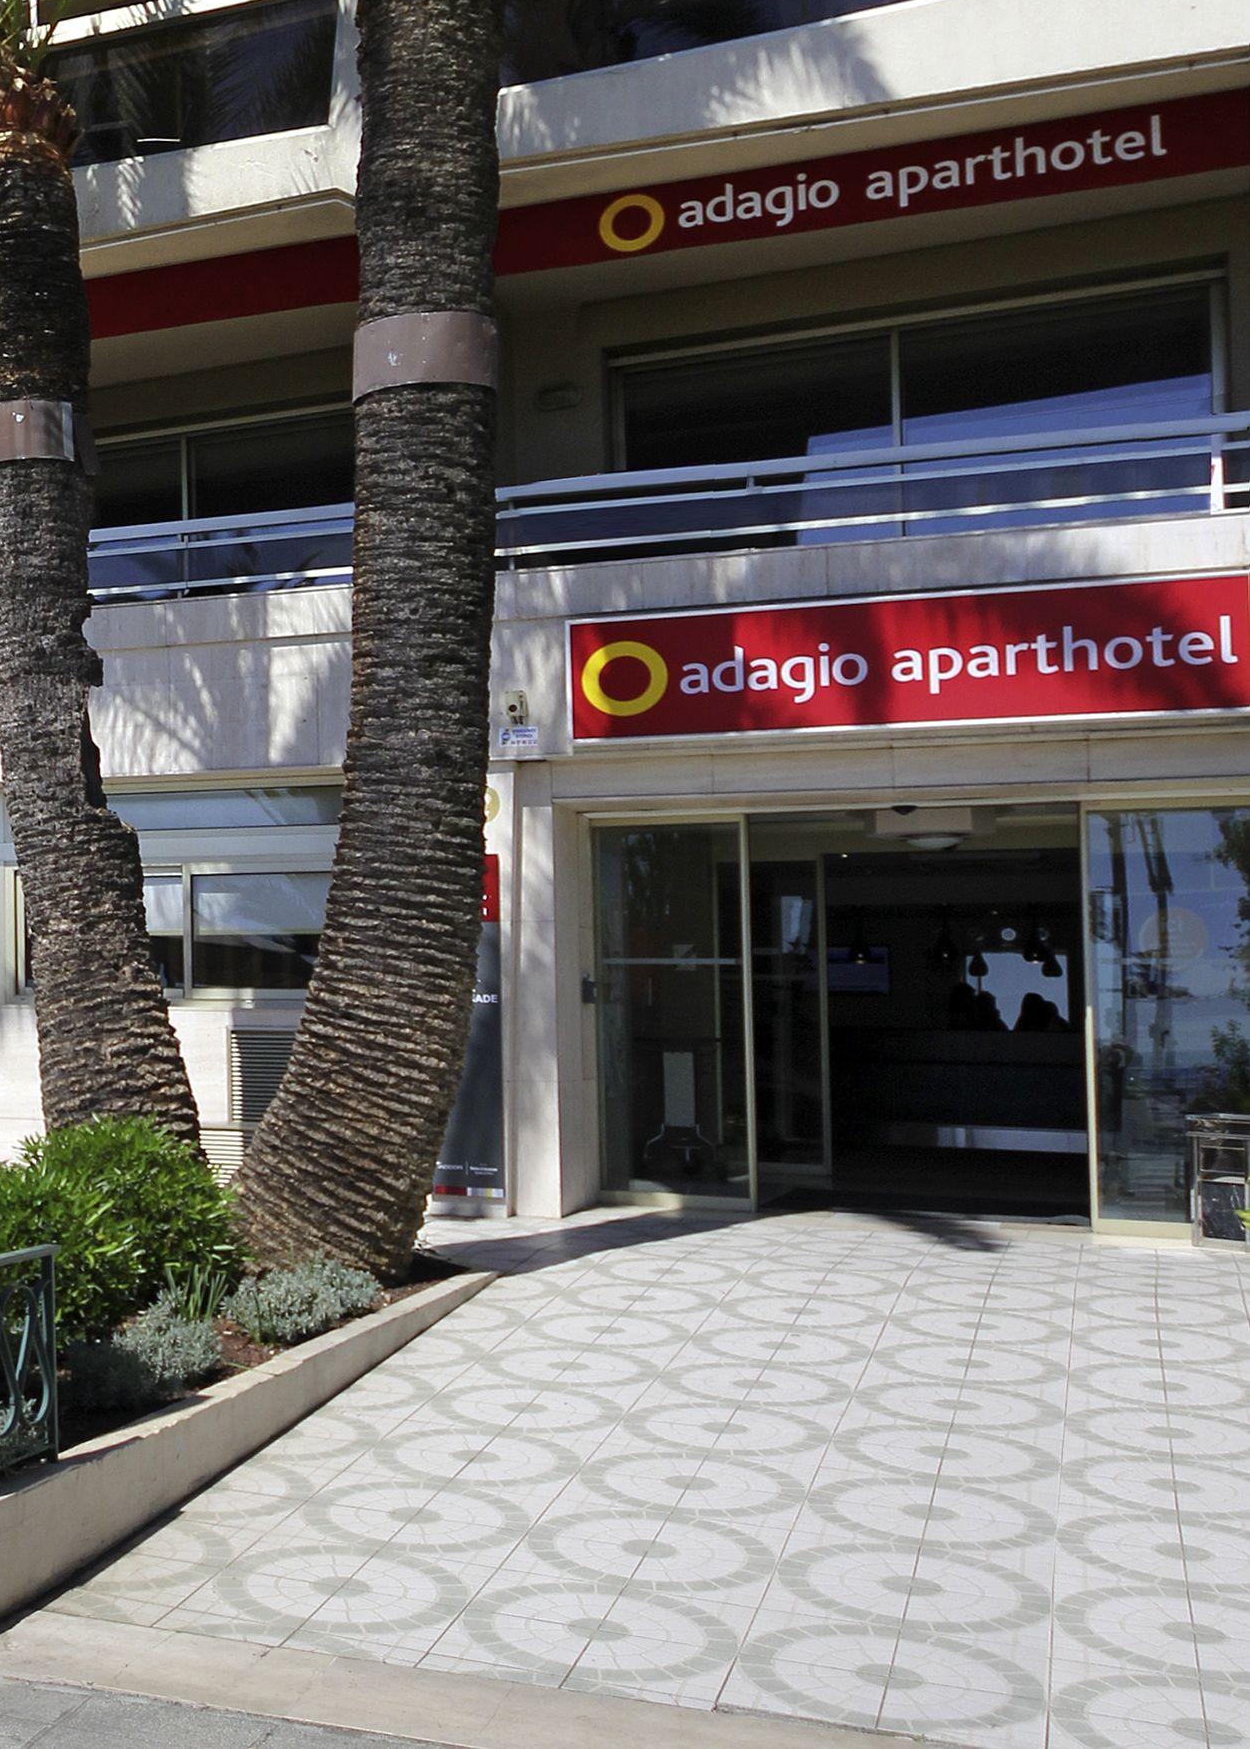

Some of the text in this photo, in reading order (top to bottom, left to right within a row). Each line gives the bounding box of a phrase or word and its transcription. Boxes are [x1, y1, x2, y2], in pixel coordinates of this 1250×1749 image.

[677, 114, 1167, 227] adagio aparthotel
[680, 615, 1238, 704] adagio aparthotel
